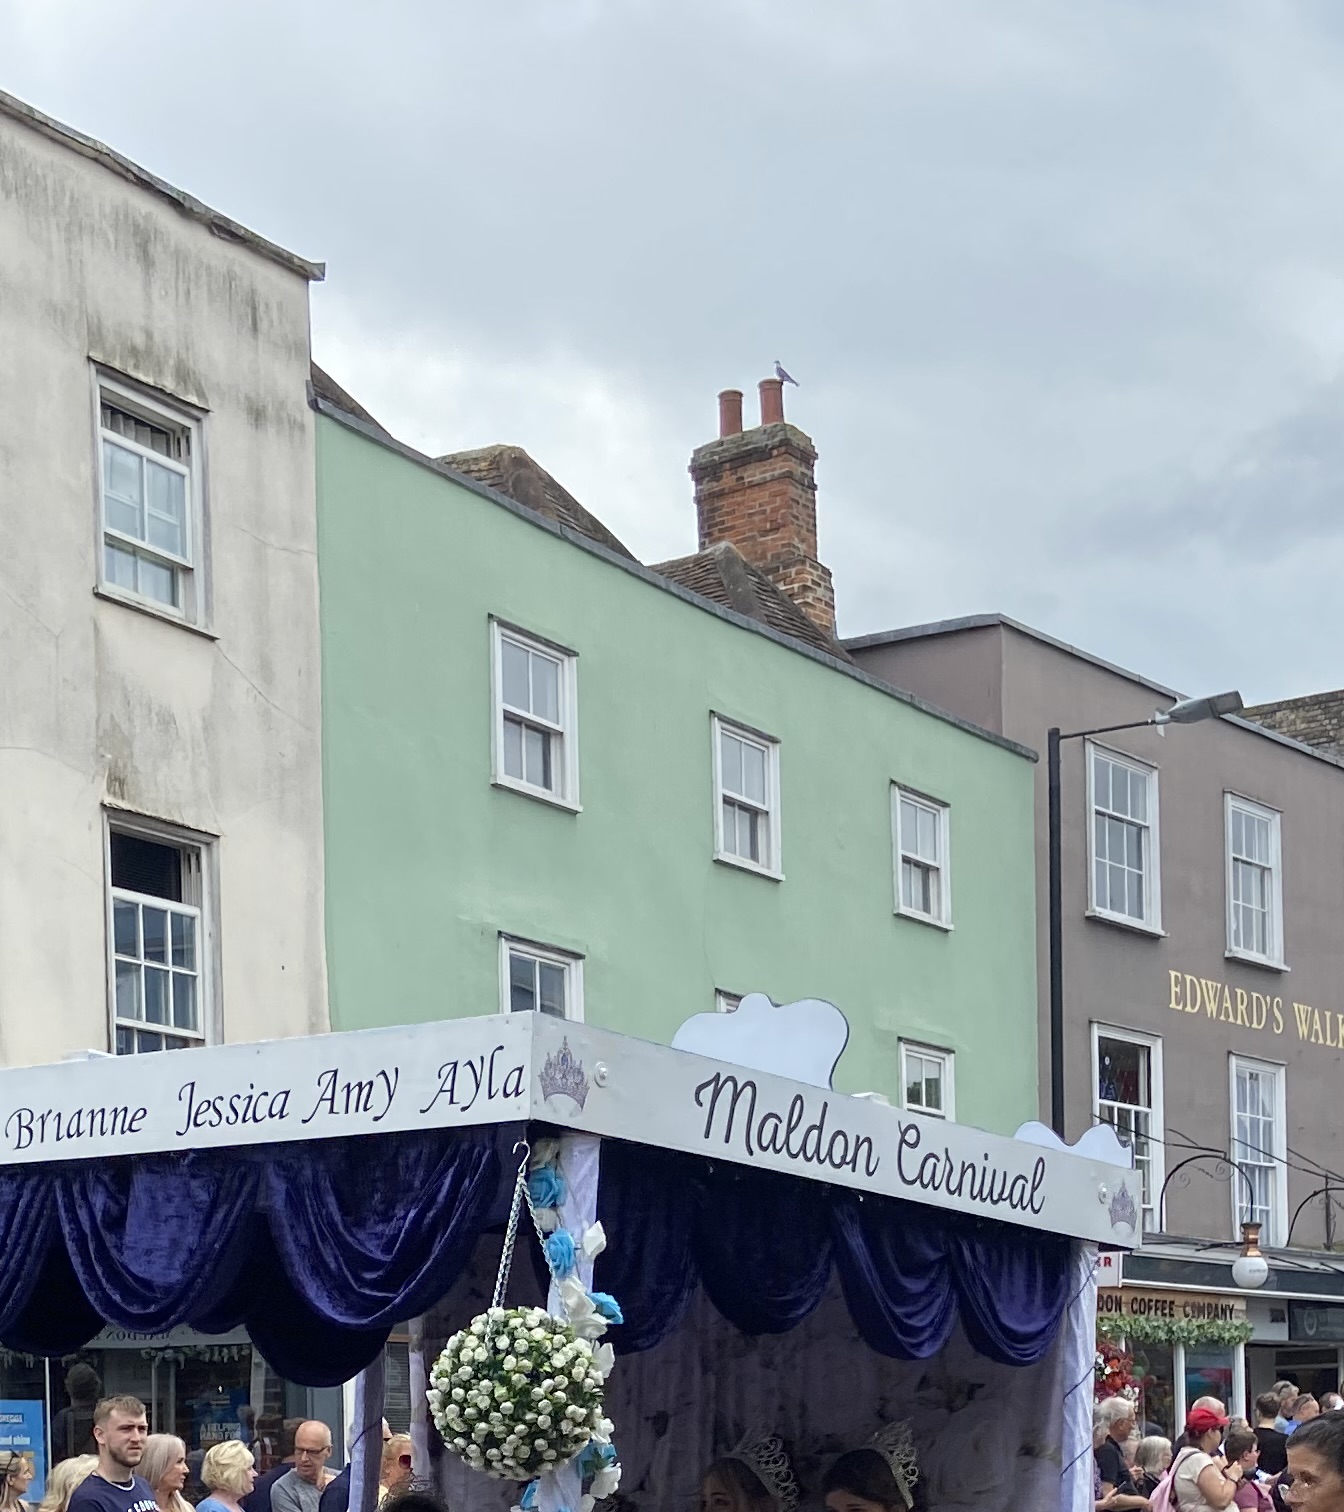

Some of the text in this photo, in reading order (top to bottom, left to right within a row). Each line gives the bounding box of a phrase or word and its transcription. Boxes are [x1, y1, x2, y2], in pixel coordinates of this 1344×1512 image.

[1168, 969, 1284, 1035] EDWARD'S
[4, 1104, 148, 1151] Brianne
[176, 1080, 290, 1137] Jessica
[301, 1064, 399, 1126] Amy
[420, 1044, 527, 1112] Ayla
[694, 1071, 1047, 1215] Maldon Carnival
[1130, 1296, 1176, 1318] COFFEE
